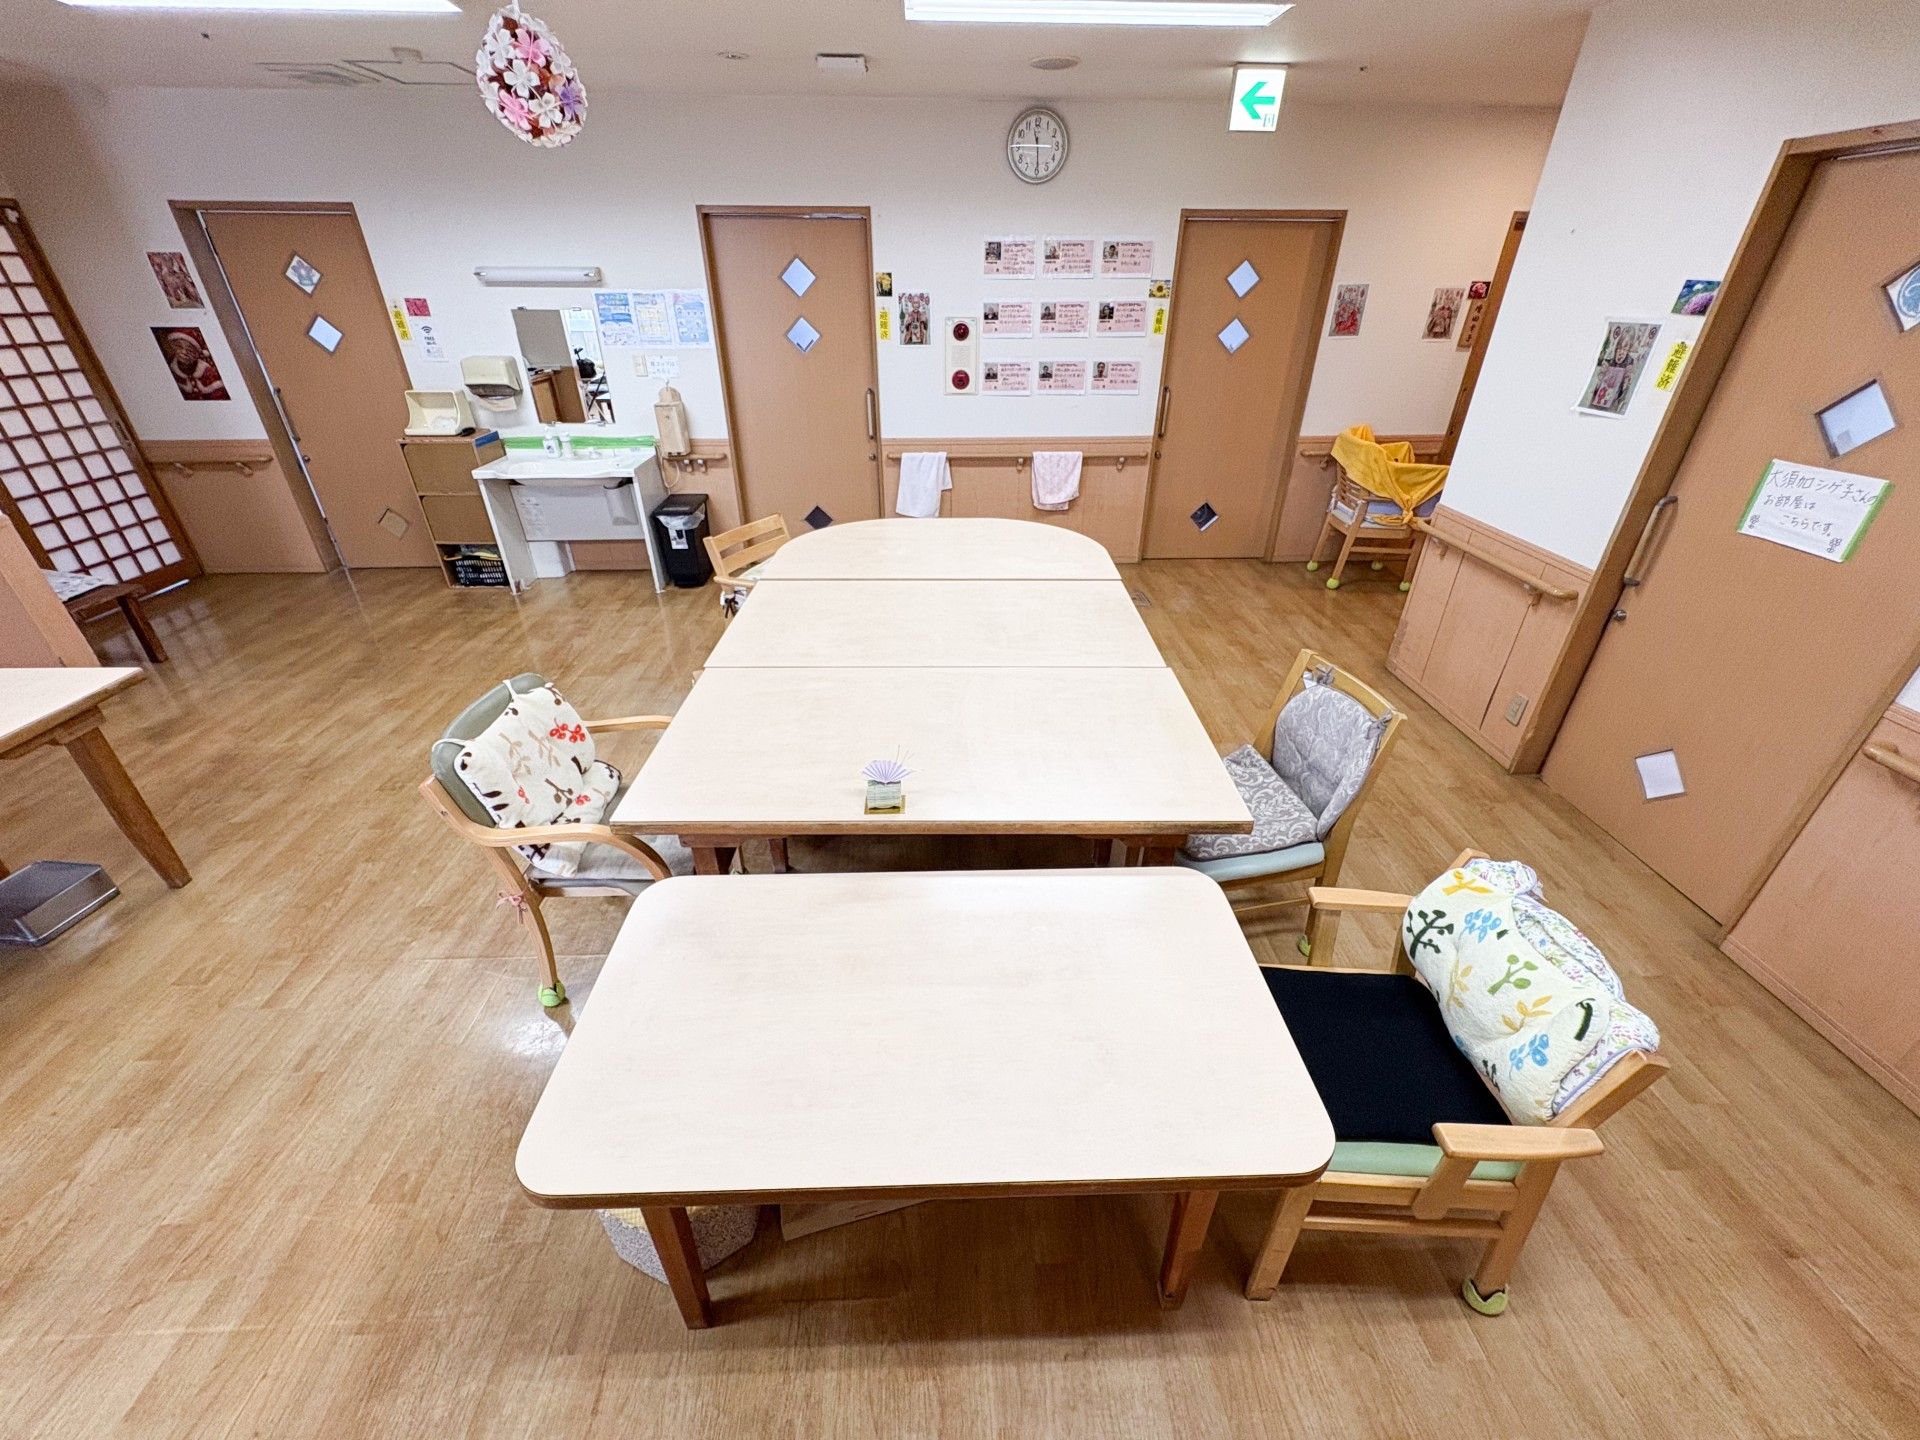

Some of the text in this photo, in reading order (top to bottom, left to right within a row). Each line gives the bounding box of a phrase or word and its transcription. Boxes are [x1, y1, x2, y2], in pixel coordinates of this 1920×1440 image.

[1026, 121, 1031, 131] 11
[1035, 117, 1042, 128] 12
[1018, 129, 1025, 139] 10
[1052, 129, 1057, 138] 2
[1054, 141, 1060, 151] 3
[1018, 155, 1023, 164] 8
[1044, 163, 1050, 171] 5
[1763, 493, 1816, 510] お部屋は
[1780, 514, 1834, 538] こちらです。
